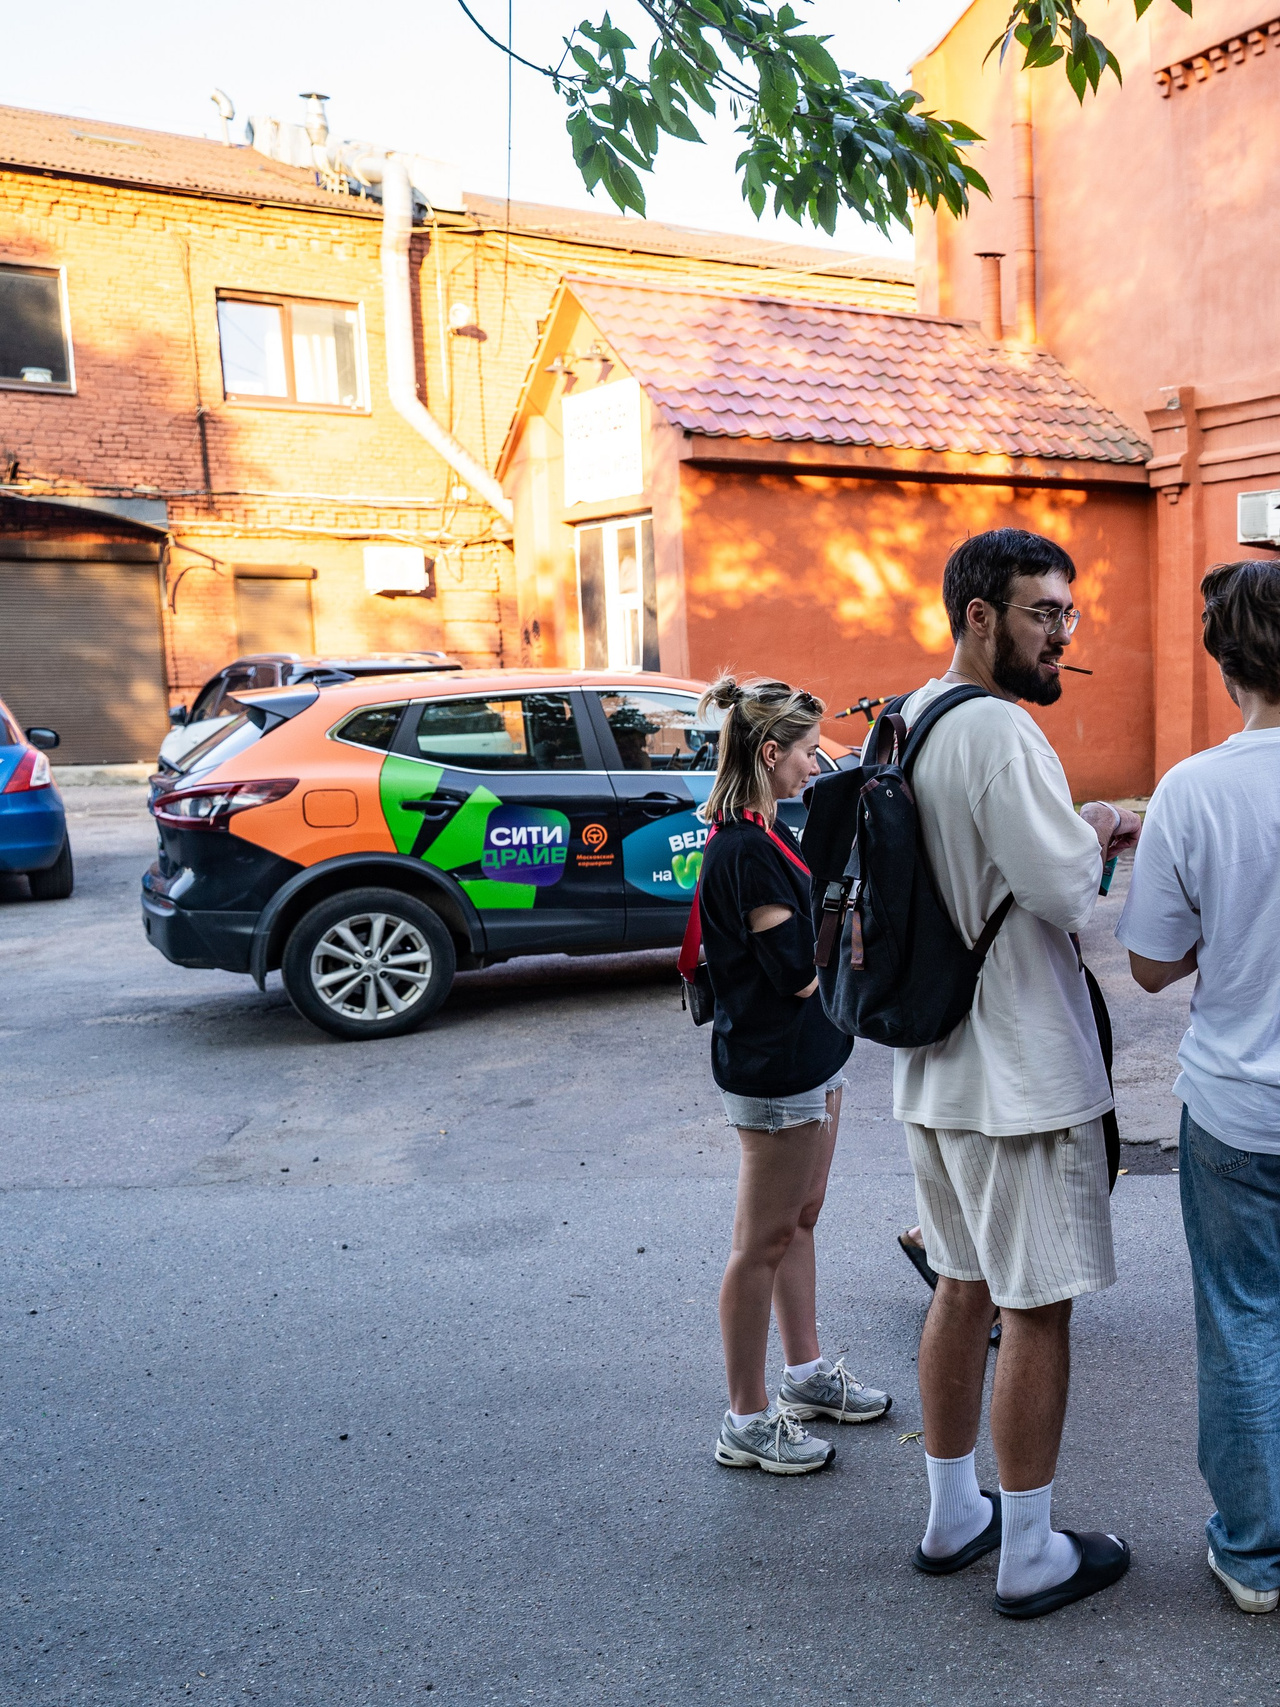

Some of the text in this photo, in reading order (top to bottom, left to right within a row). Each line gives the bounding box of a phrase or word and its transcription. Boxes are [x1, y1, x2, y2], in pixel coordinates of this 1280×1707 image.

[490, 826, 562, 846] СИТИ
[482, 844, 567, 869] ДРАЙВ
[653, 870, 672, 882] на
